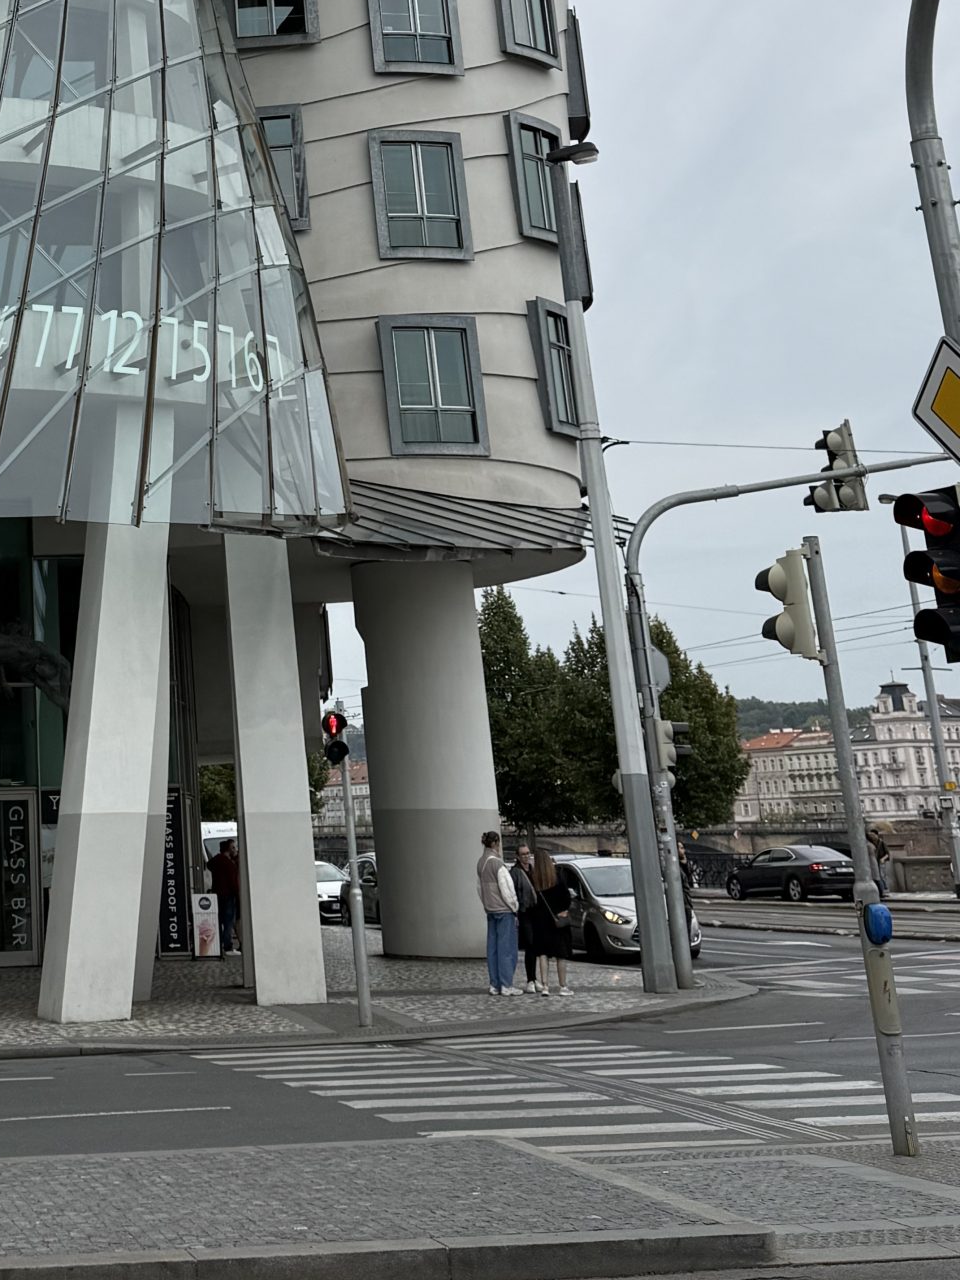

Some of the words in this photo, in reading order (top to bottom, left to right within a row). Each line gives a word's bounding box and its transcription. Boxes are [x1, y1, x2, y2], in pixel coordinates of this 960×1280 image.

[8, 805, 26, 885] GLASS
[166, 852, 175, 875] BAR
[167, 879, 177, 913] ROOF
[10, 897, 28, 946] BAR
[169, 916, 178, 940] TOP
